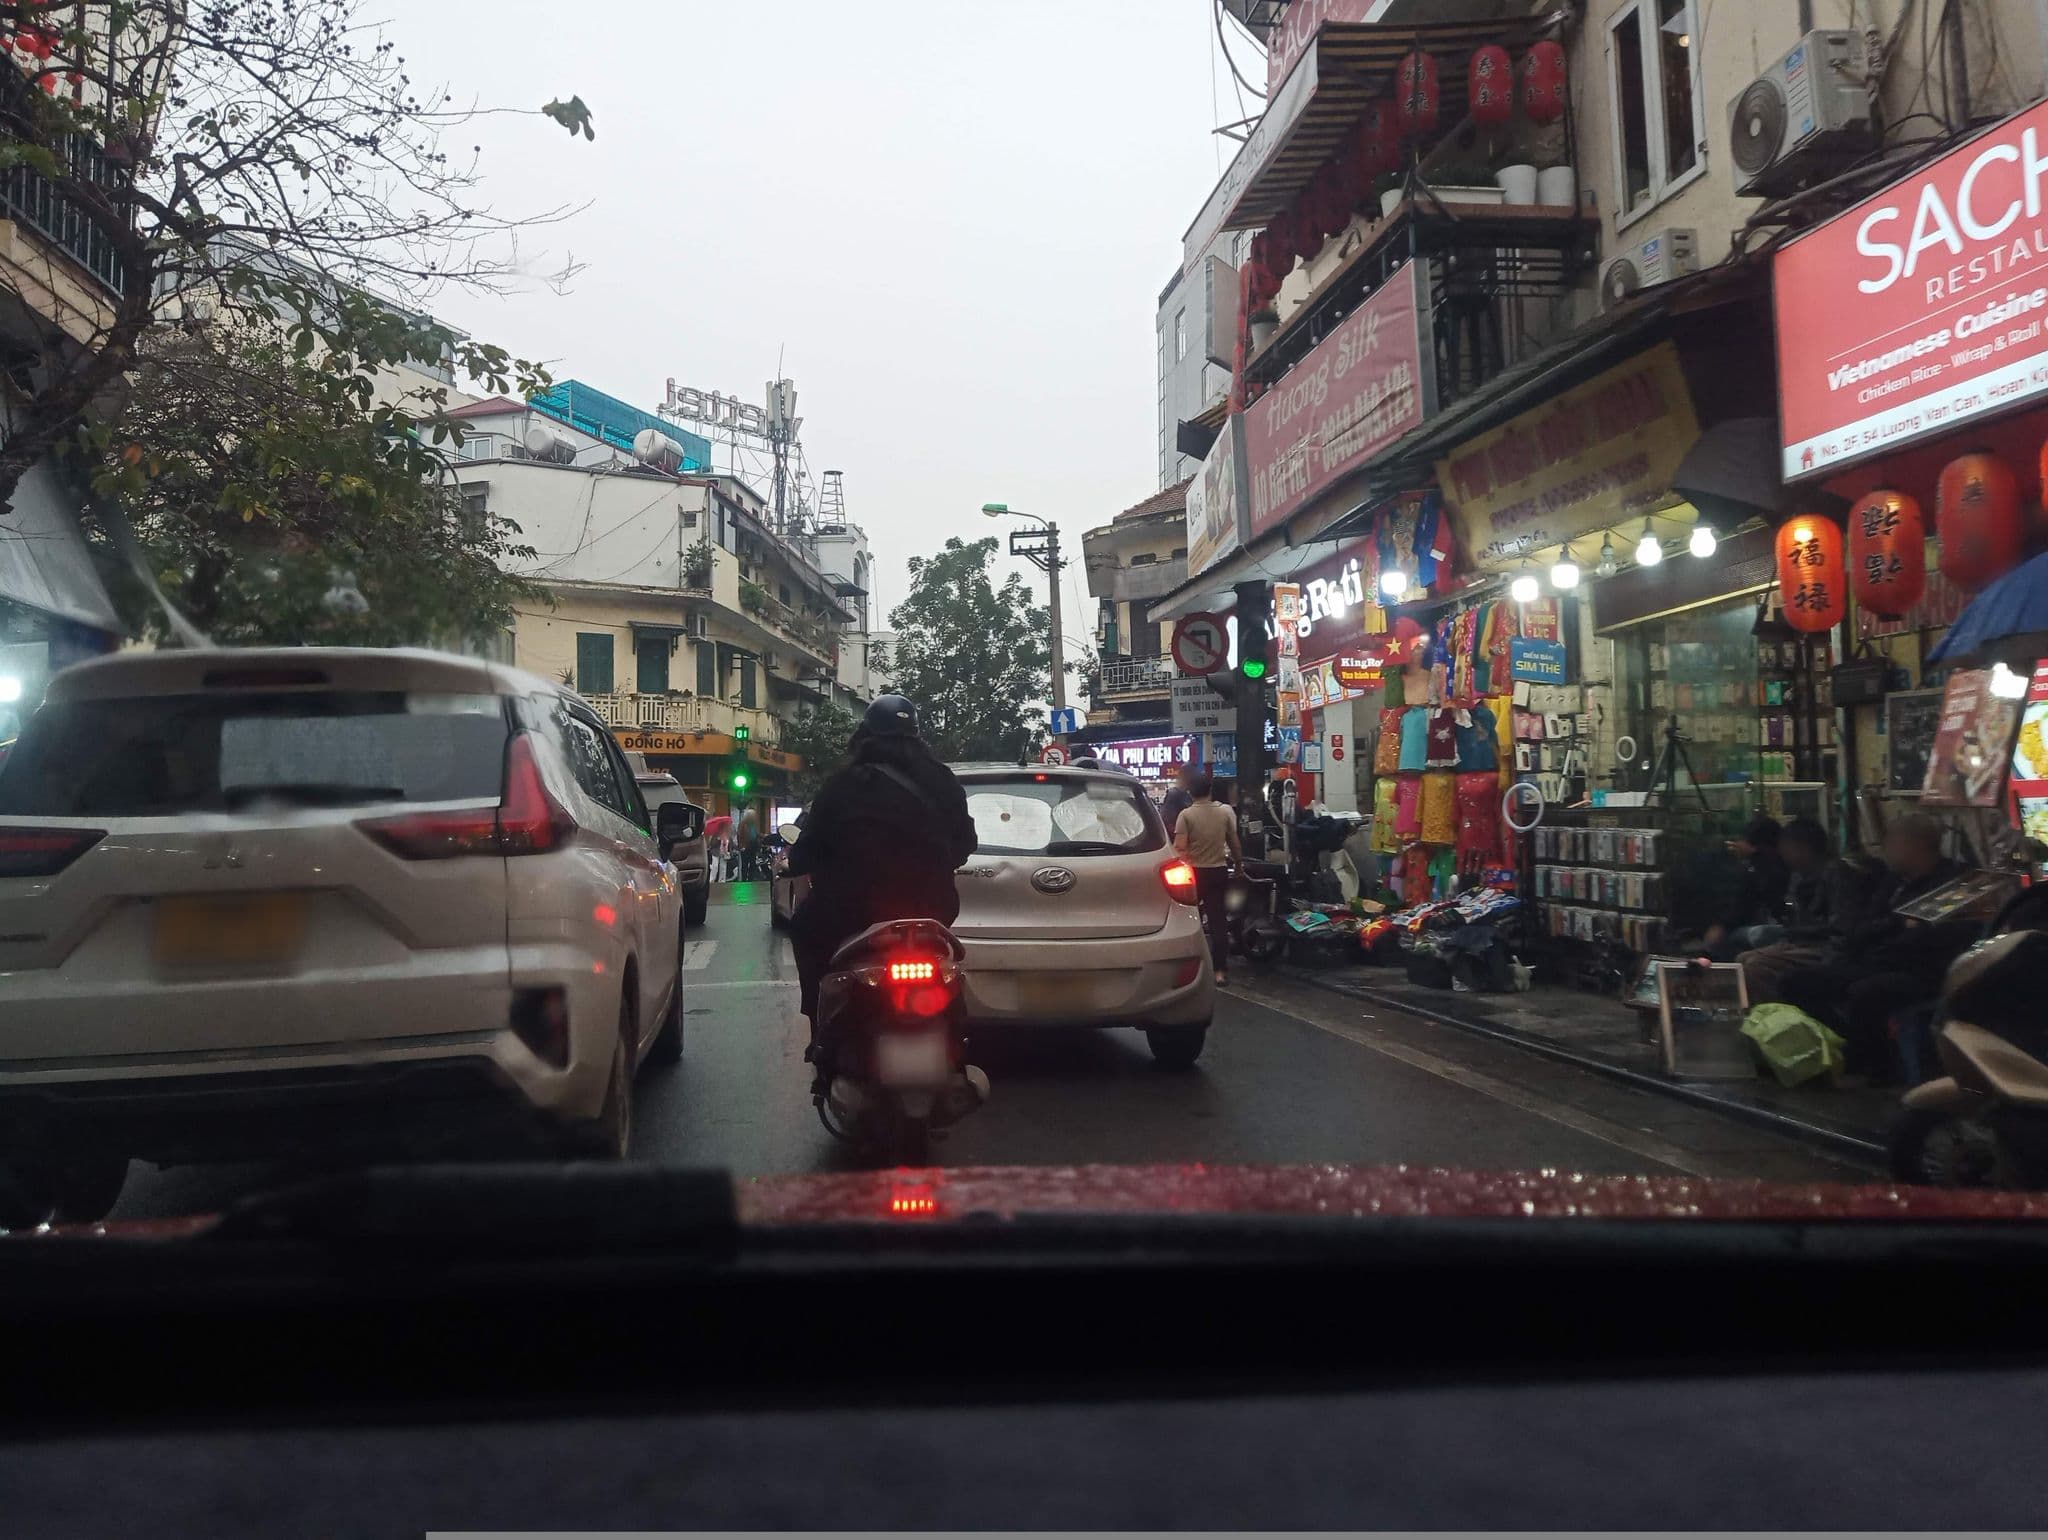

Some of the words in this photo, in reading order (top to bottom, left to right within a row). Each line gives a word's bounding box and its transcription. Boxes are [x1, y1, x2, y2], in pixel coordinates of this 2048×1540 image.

[1335, 308, 1380, 380] Silk
[1827, 329, 1952, 391] Vietnamese
[1954, 286, 2048, 339] Cuisine
[1858, 375, 1910, 403] Chicken
[1911, 363, 1943, 384] Rice
[1951, 344, 1993, 367] Wrap
[2008, 320, 2040, 345] Roll
[1515, 660, 1537, 672] SIM
[624, 733, 663, 749] ĐỒNG
[666, 733, 686, 749] HỒ
[1123, 746, 1144, 767] PHỤ
[1146, 743, 1172, 766] KIỆN
[1175, 739, 1191, 762] SỐ
